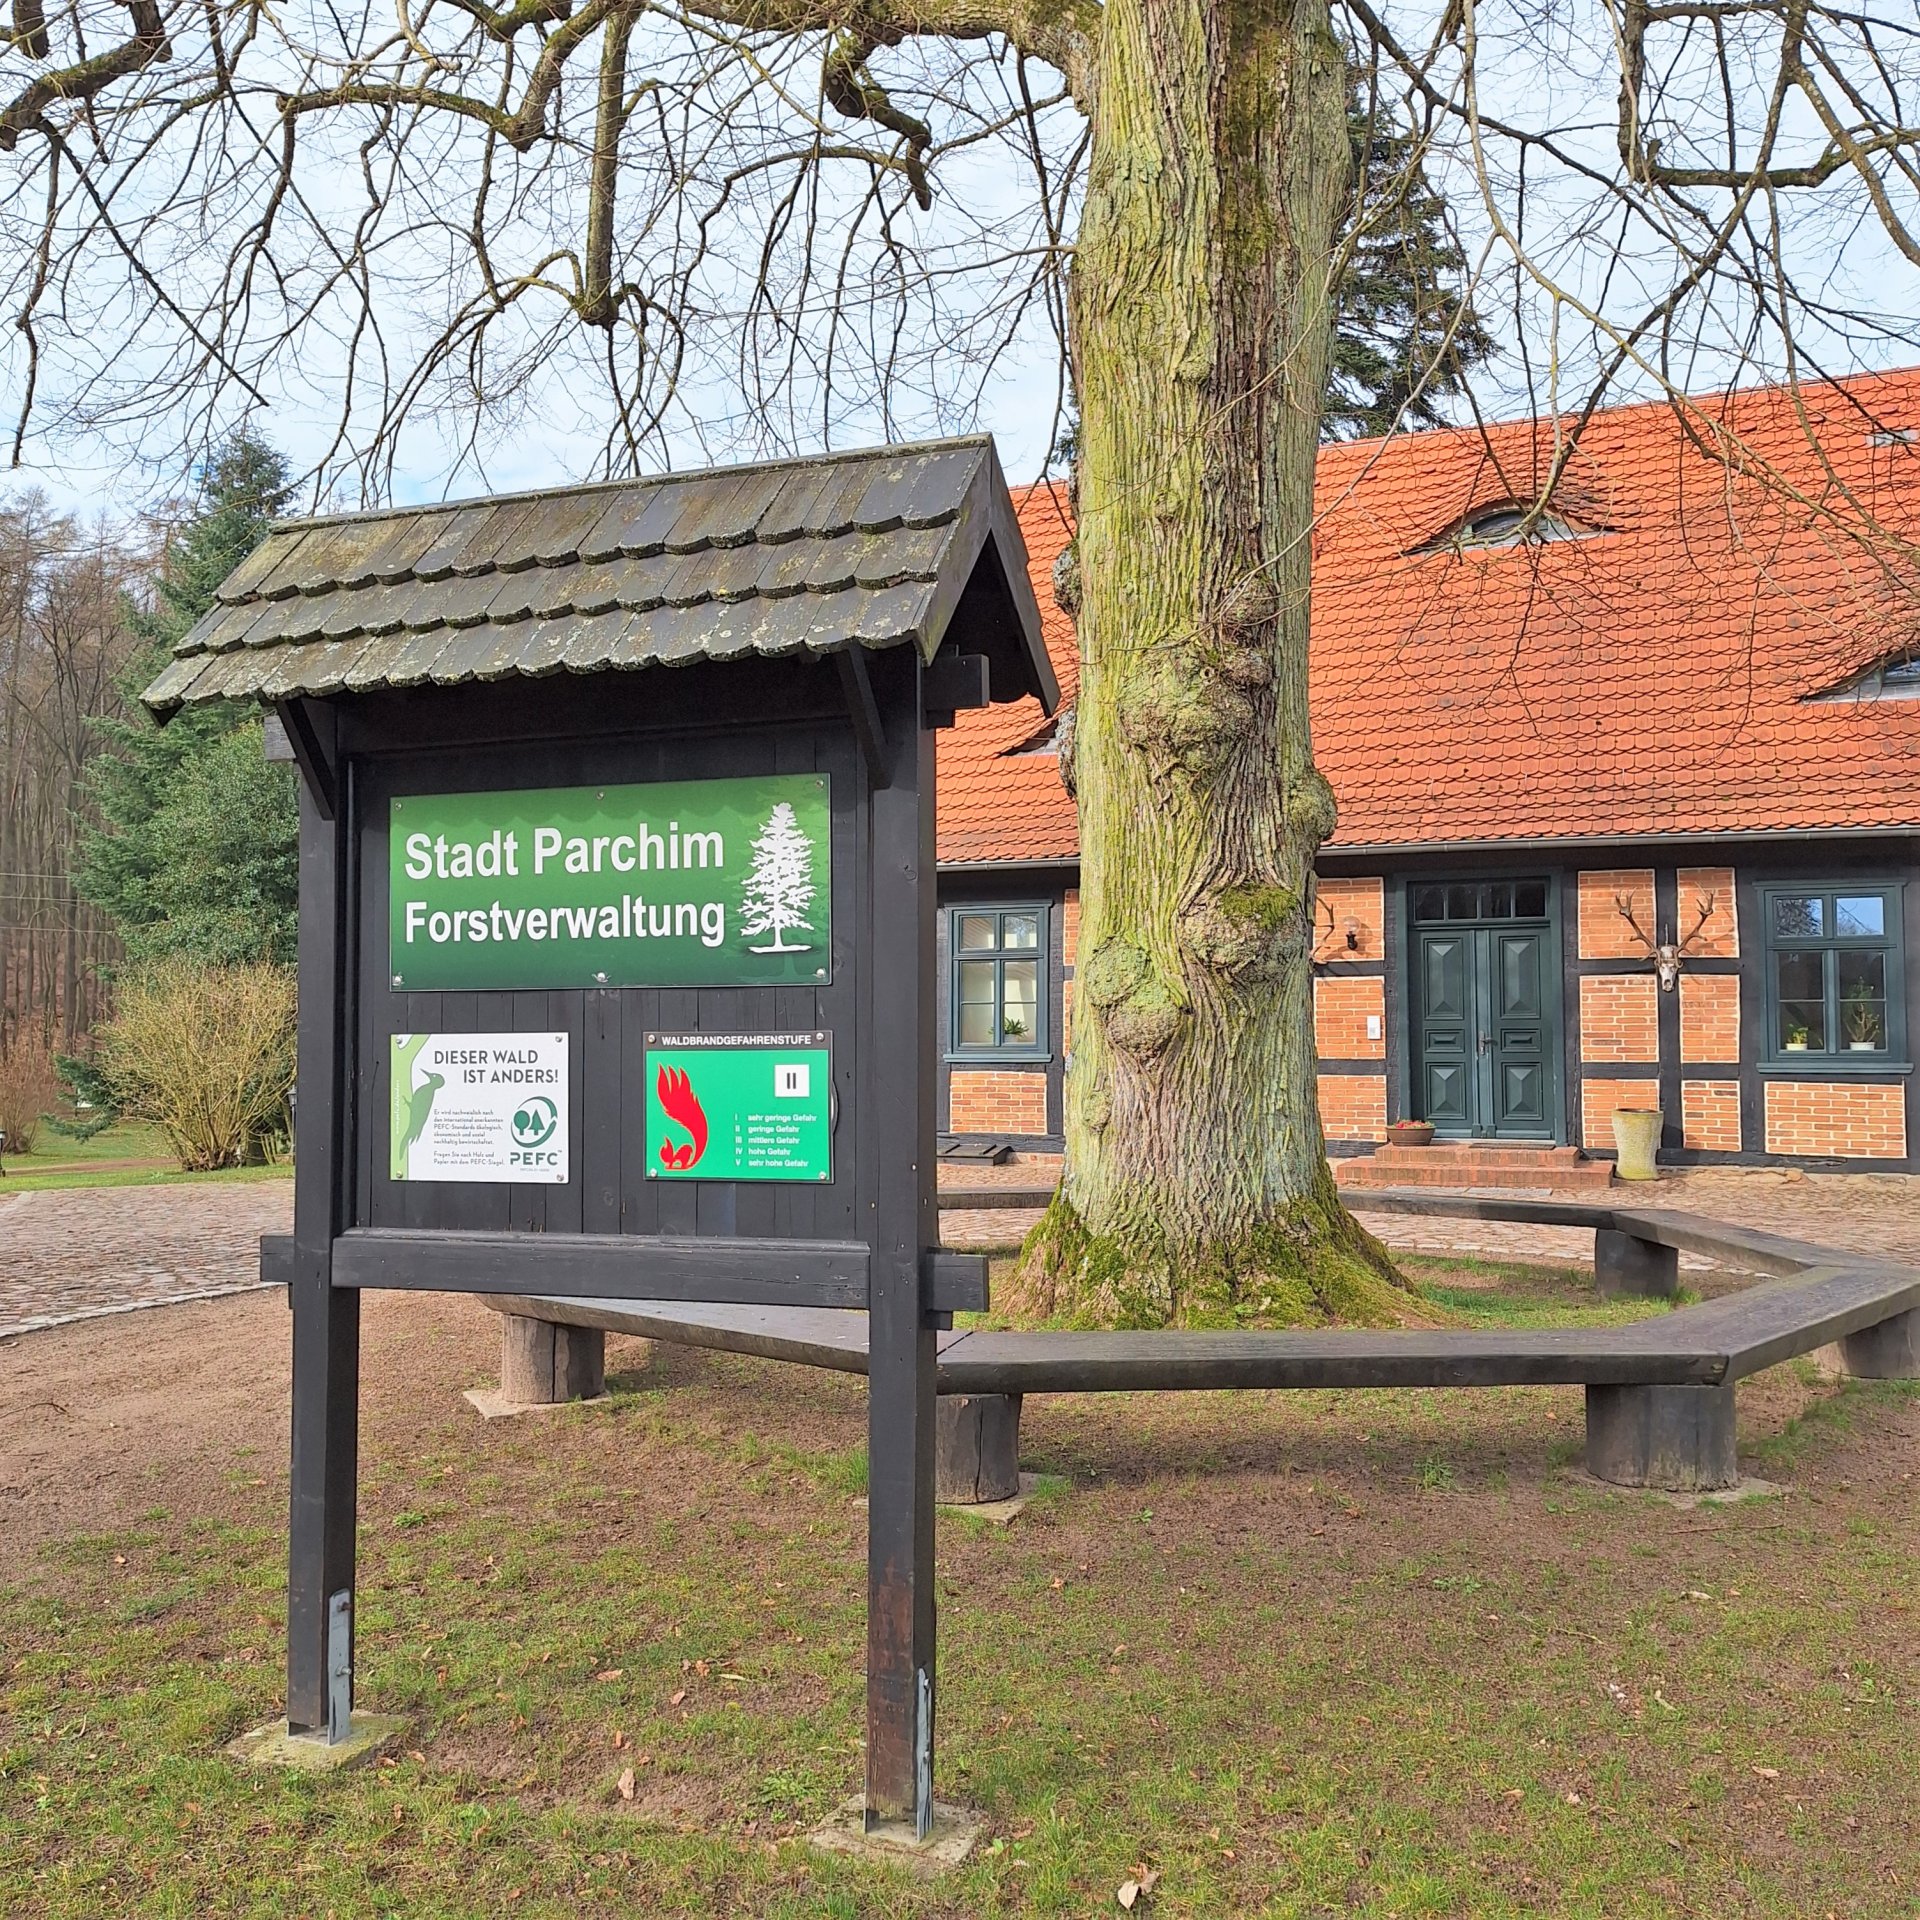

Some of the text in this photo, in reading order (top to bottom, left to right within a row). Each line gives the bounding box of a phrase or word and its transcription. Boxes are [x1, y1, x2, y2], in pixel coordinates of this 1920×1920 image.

[404, 821, 724, 880] Stadt Parchim
[405, 894, 725, 948] Forstverwaltung
[662, 1035, 812, 1046] WALDBRANDGEFAHRENSTUFE
[434, 1050, 539, 1064] DIESER WALD
[463, 1069, 559, 1083] IST ANDERS!
[786, 1072, 797, 1090] II
[764, 1114, 791, 1123] geringe
[735, 1124, 740, 1132] II
[748, 1125, 774, 1134] geringe
[510, 1152, 558, 1166] PEFC
